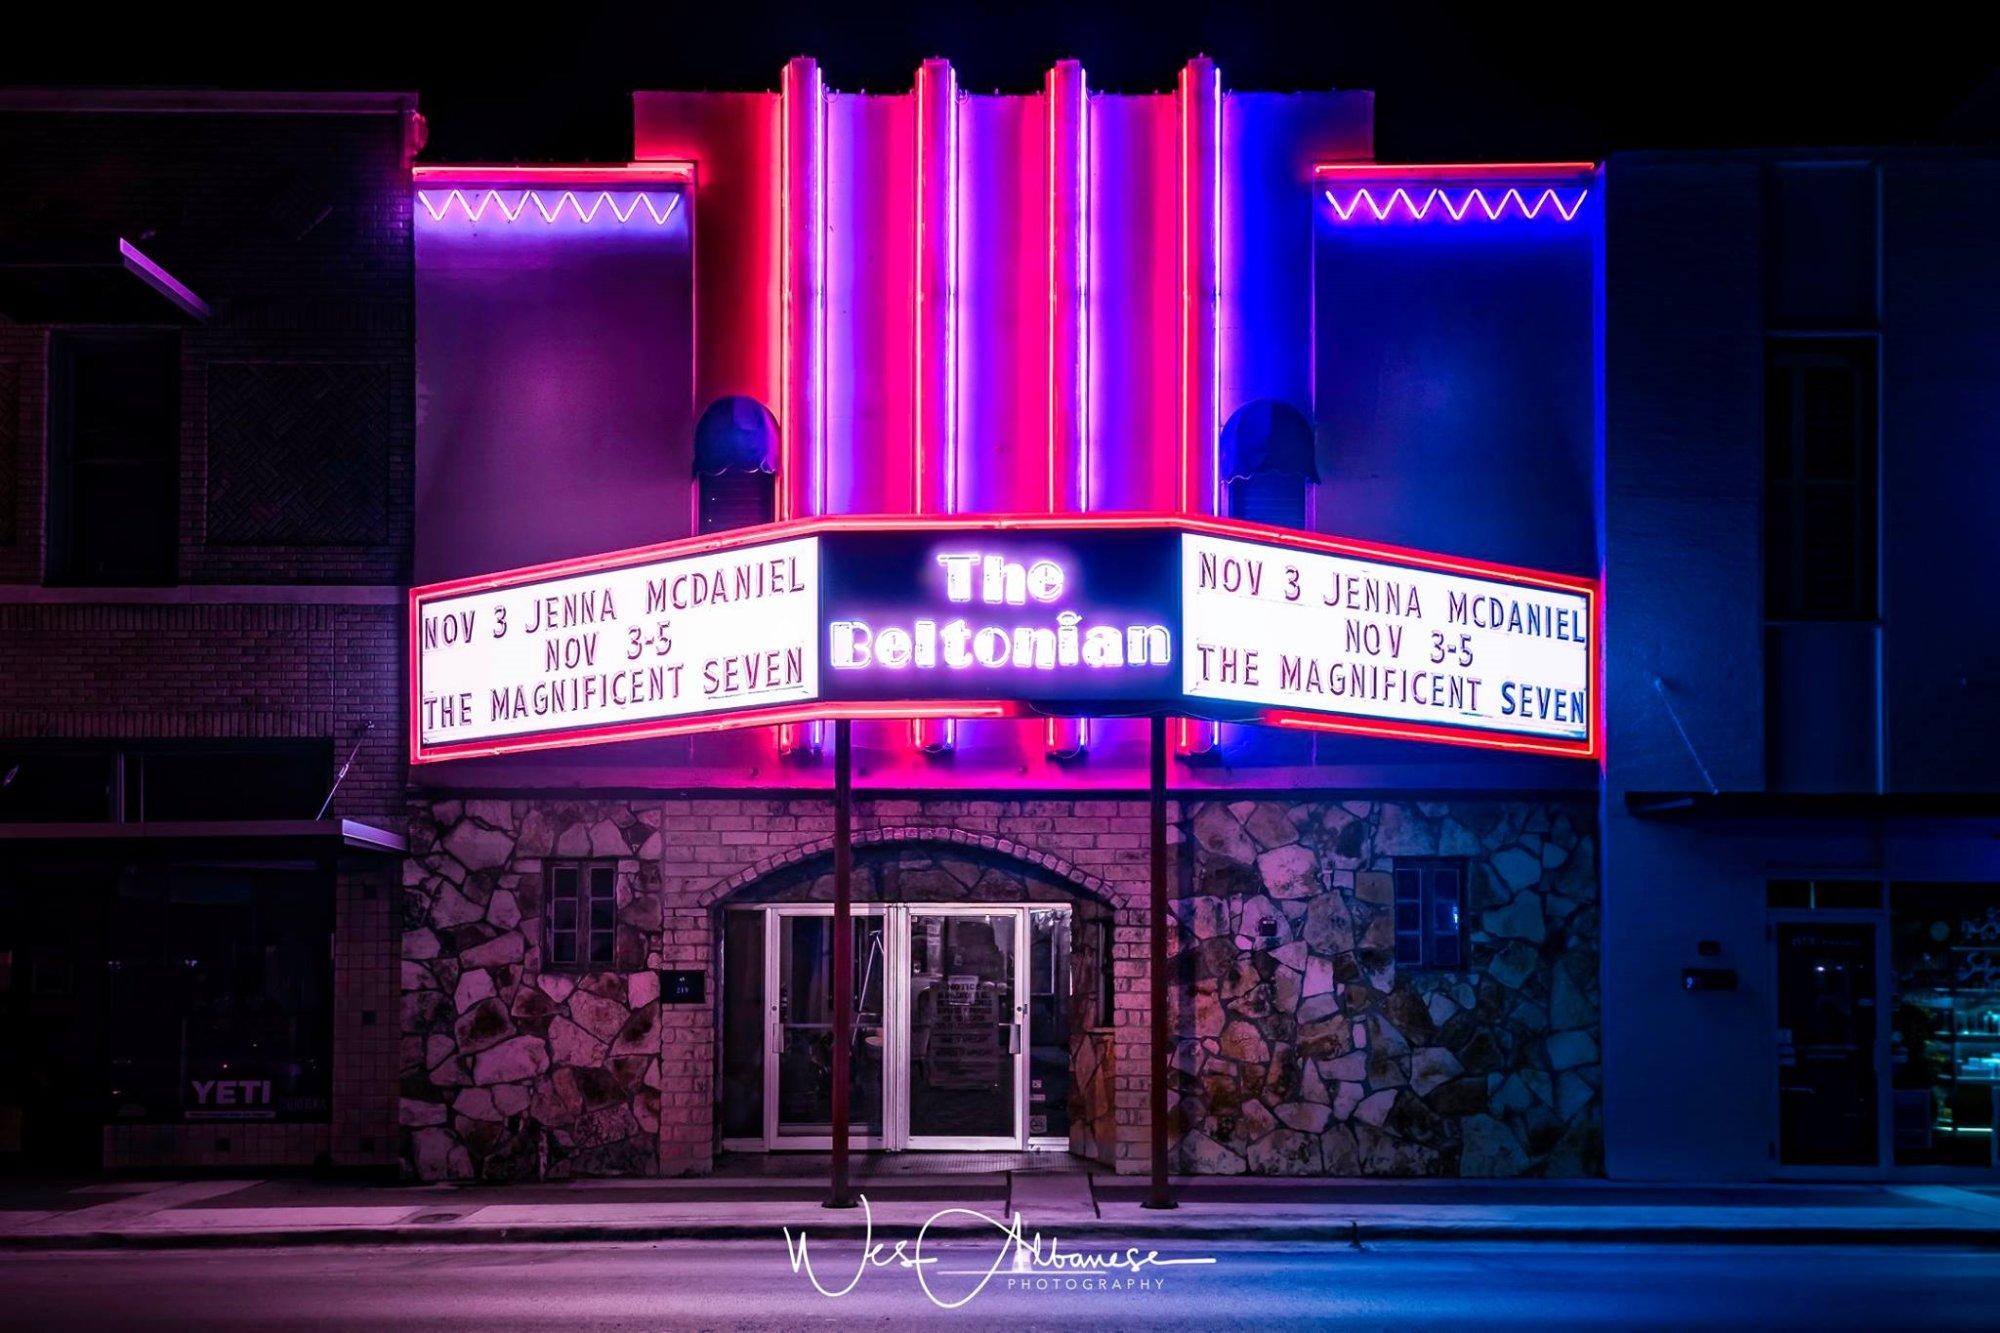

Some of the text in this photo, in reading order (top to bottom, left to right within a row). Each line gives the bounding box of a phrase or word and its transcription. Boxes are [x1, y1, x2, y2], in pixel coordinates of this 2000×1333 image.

[424, 556, 805, 650] NOV 3 JENNA MCDANIEL
[937, 553, 1064, 605] The
[1198, 551, 1587, 644] NOV 3 JENNA MCDANIEL
[545, 620, 673, 672] NOV 3-5
[829, 611, 1172, 669] Beltonian
[1345, 619, 1474, 668] NOV 3-5
[423, 646, 803, 731] THE MAGNIFICENT SEVEN
[1196, 642, 1586, 725] THE MAGNIFICENT SEVEN
[190, 1079, 273, 1105] YETI
